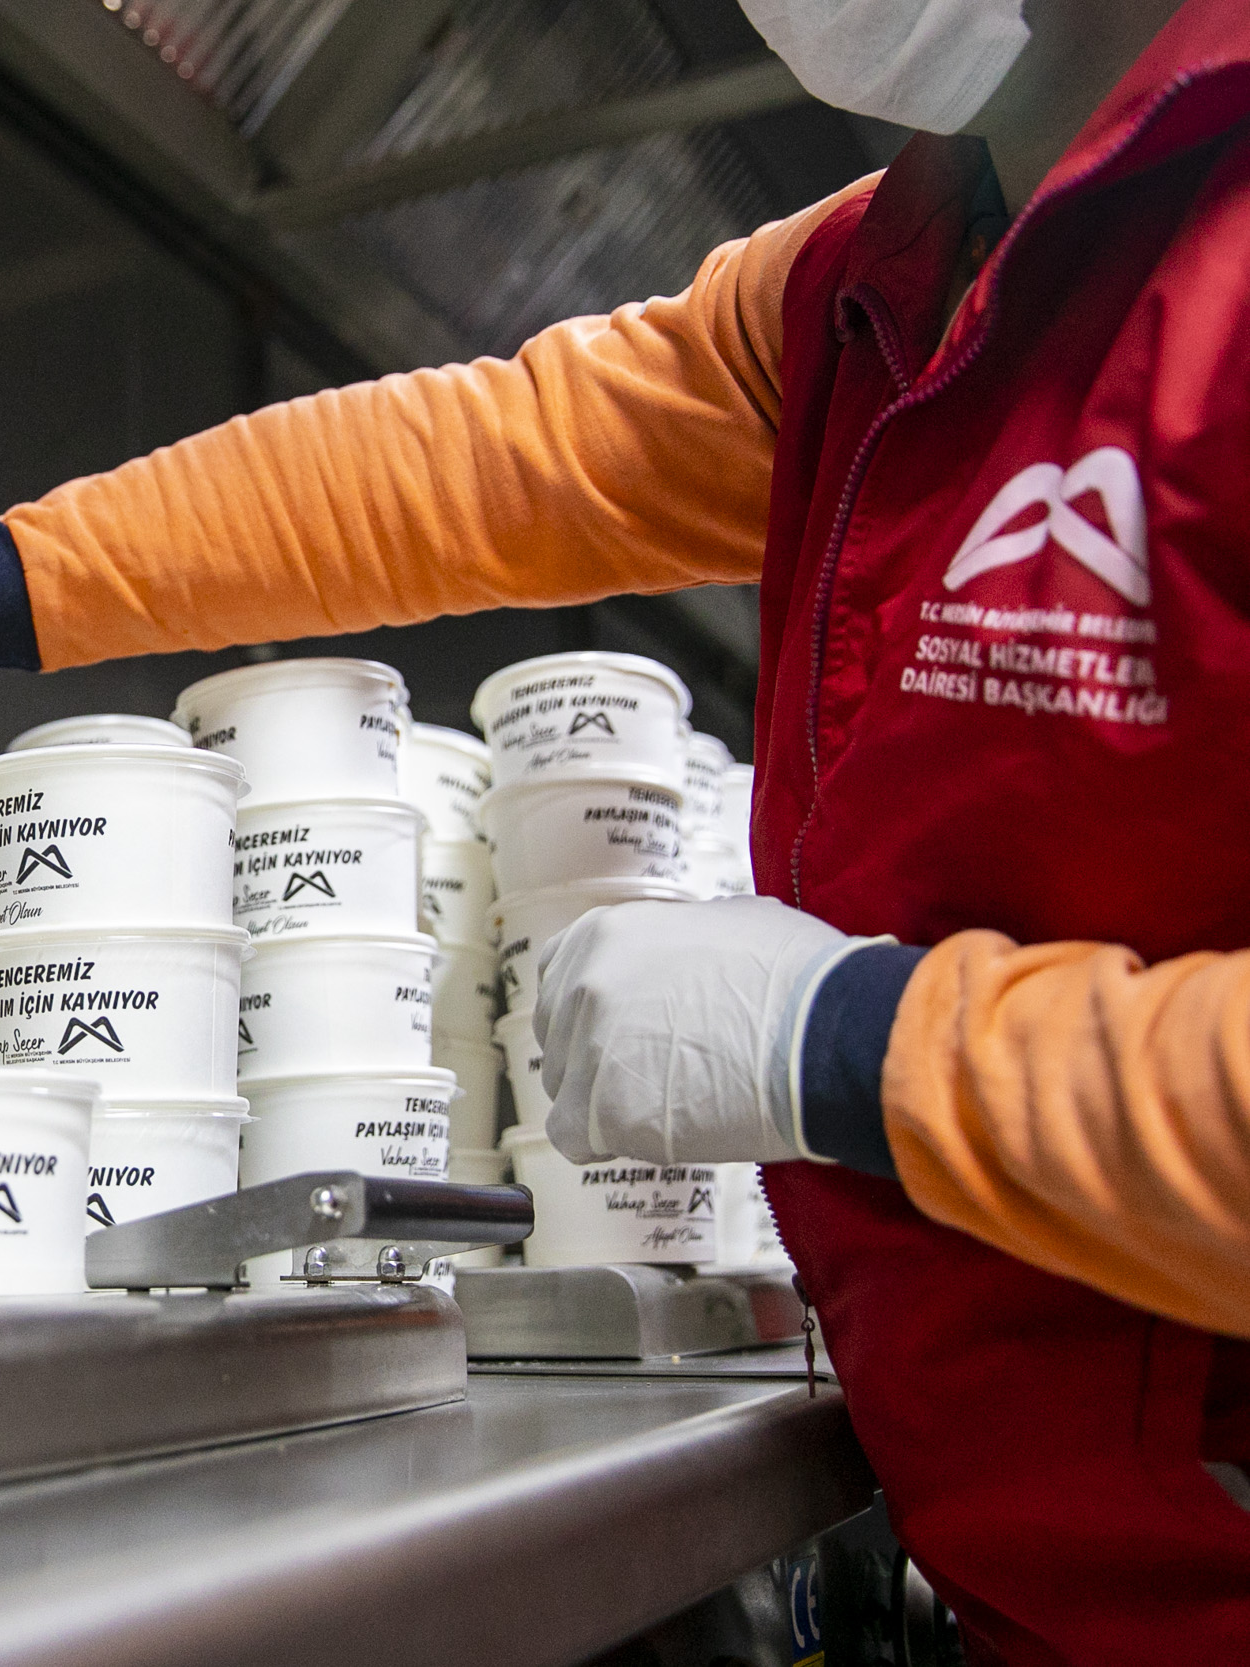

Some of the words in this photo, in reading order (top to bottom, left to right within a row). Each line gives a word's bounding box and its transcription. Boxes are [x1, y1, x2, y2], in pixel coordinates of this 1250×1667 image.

[915, 634, 983, 669] SOSYAL
[901, 666, 978, 702] DAİRESİ
[17, 817, 107, 843] KAYNIYOR
[235, 825, 310, 852] NCEREMİZ
[248, 852, 277, 876] İÇİN
[284, 849, 363, 867] KAYNIYOR
[9, 901, 43, 926] Olsun
[19, 990, 54, 1020] İÇİN
[60, 989, 159, 1012] KAYNIYOR
[13, 1028, 46, 1053] Seçer
[355, 1121, 425, 1140] PAYLAŞIM
[381, 1144, 417, 1174] Vahap
[582, 1167, 655, 1187] PAYLAŞIM
